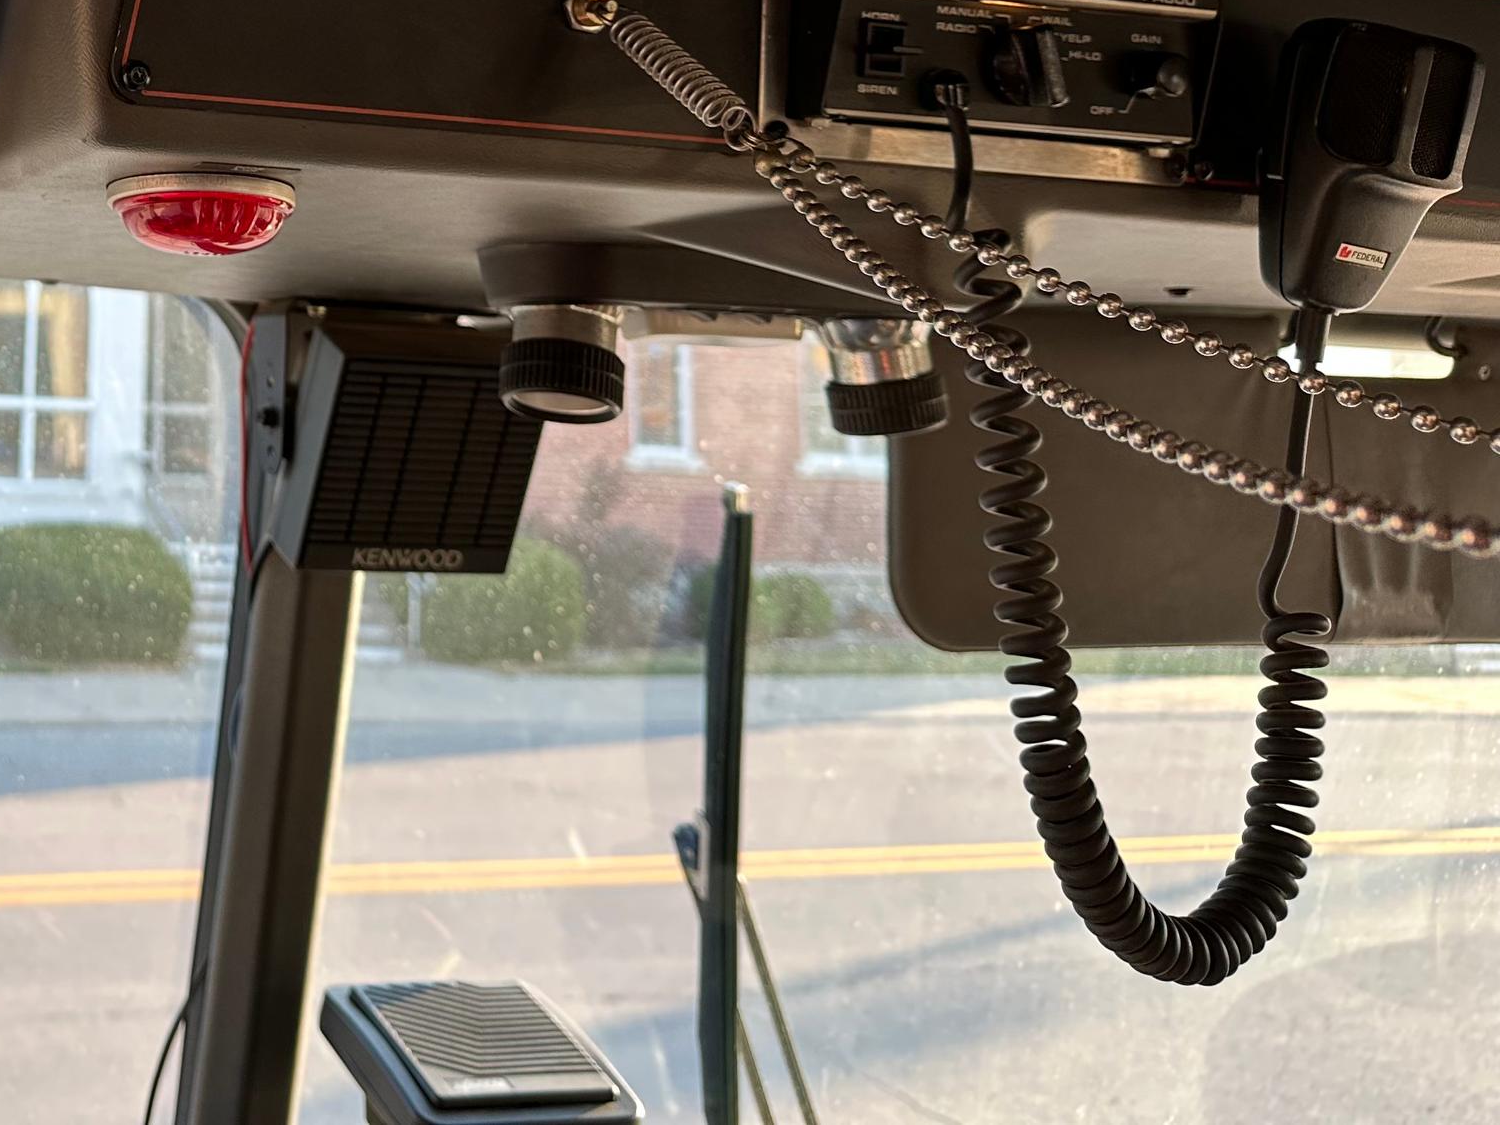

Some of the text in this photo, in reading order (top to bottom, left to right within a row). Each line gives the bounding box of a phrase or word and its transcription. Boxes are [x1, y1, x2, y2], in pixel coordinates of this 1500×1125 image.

[936, 4, 993, 19] MANUAL
[936, 21, 977, 34] RADIO
[1060, 32, 1092, 44] YELP
[1131, 32, 1163, 44] GAIN
[1068, 50, 1102, 62] HI-LO
[857, 83, 898, 95] SIREN
[1089, 105, 1114, 116] OFF
[1351, 250, 1384, 264] FEDERAL
[352, 546, 464, 570] KENWOOD
